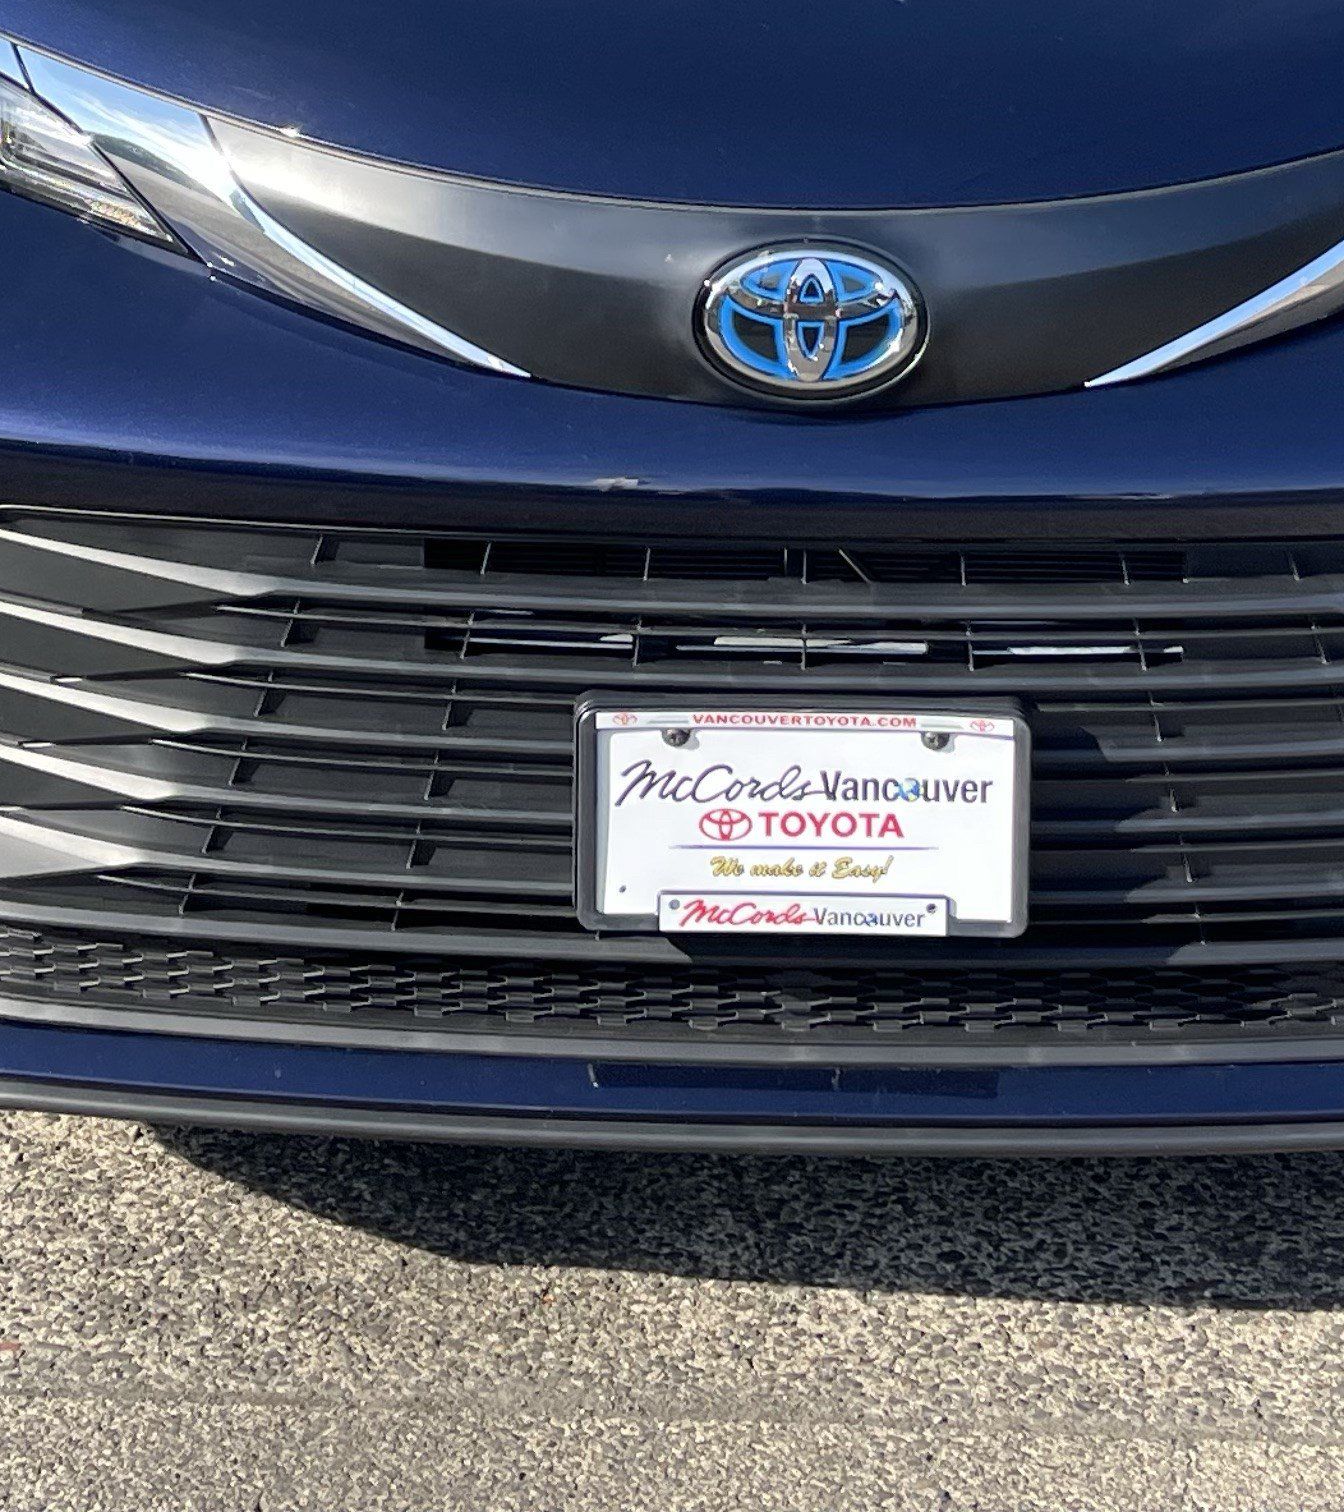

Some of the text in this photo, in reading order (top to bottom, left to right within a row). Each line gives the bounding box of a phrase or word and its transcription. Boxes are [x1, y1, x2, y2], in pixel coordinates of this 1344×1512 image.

[691, 714, 917, 728] VANCOUVERTOYOTA.COM
[614, 759, 993, 807] McCords Vancouver
[758, 811, 904, 839] TOYOTA
[710, 855, 894, 883] We make it Easy!
[679, 899, 926, 928] McCords Vancouver
